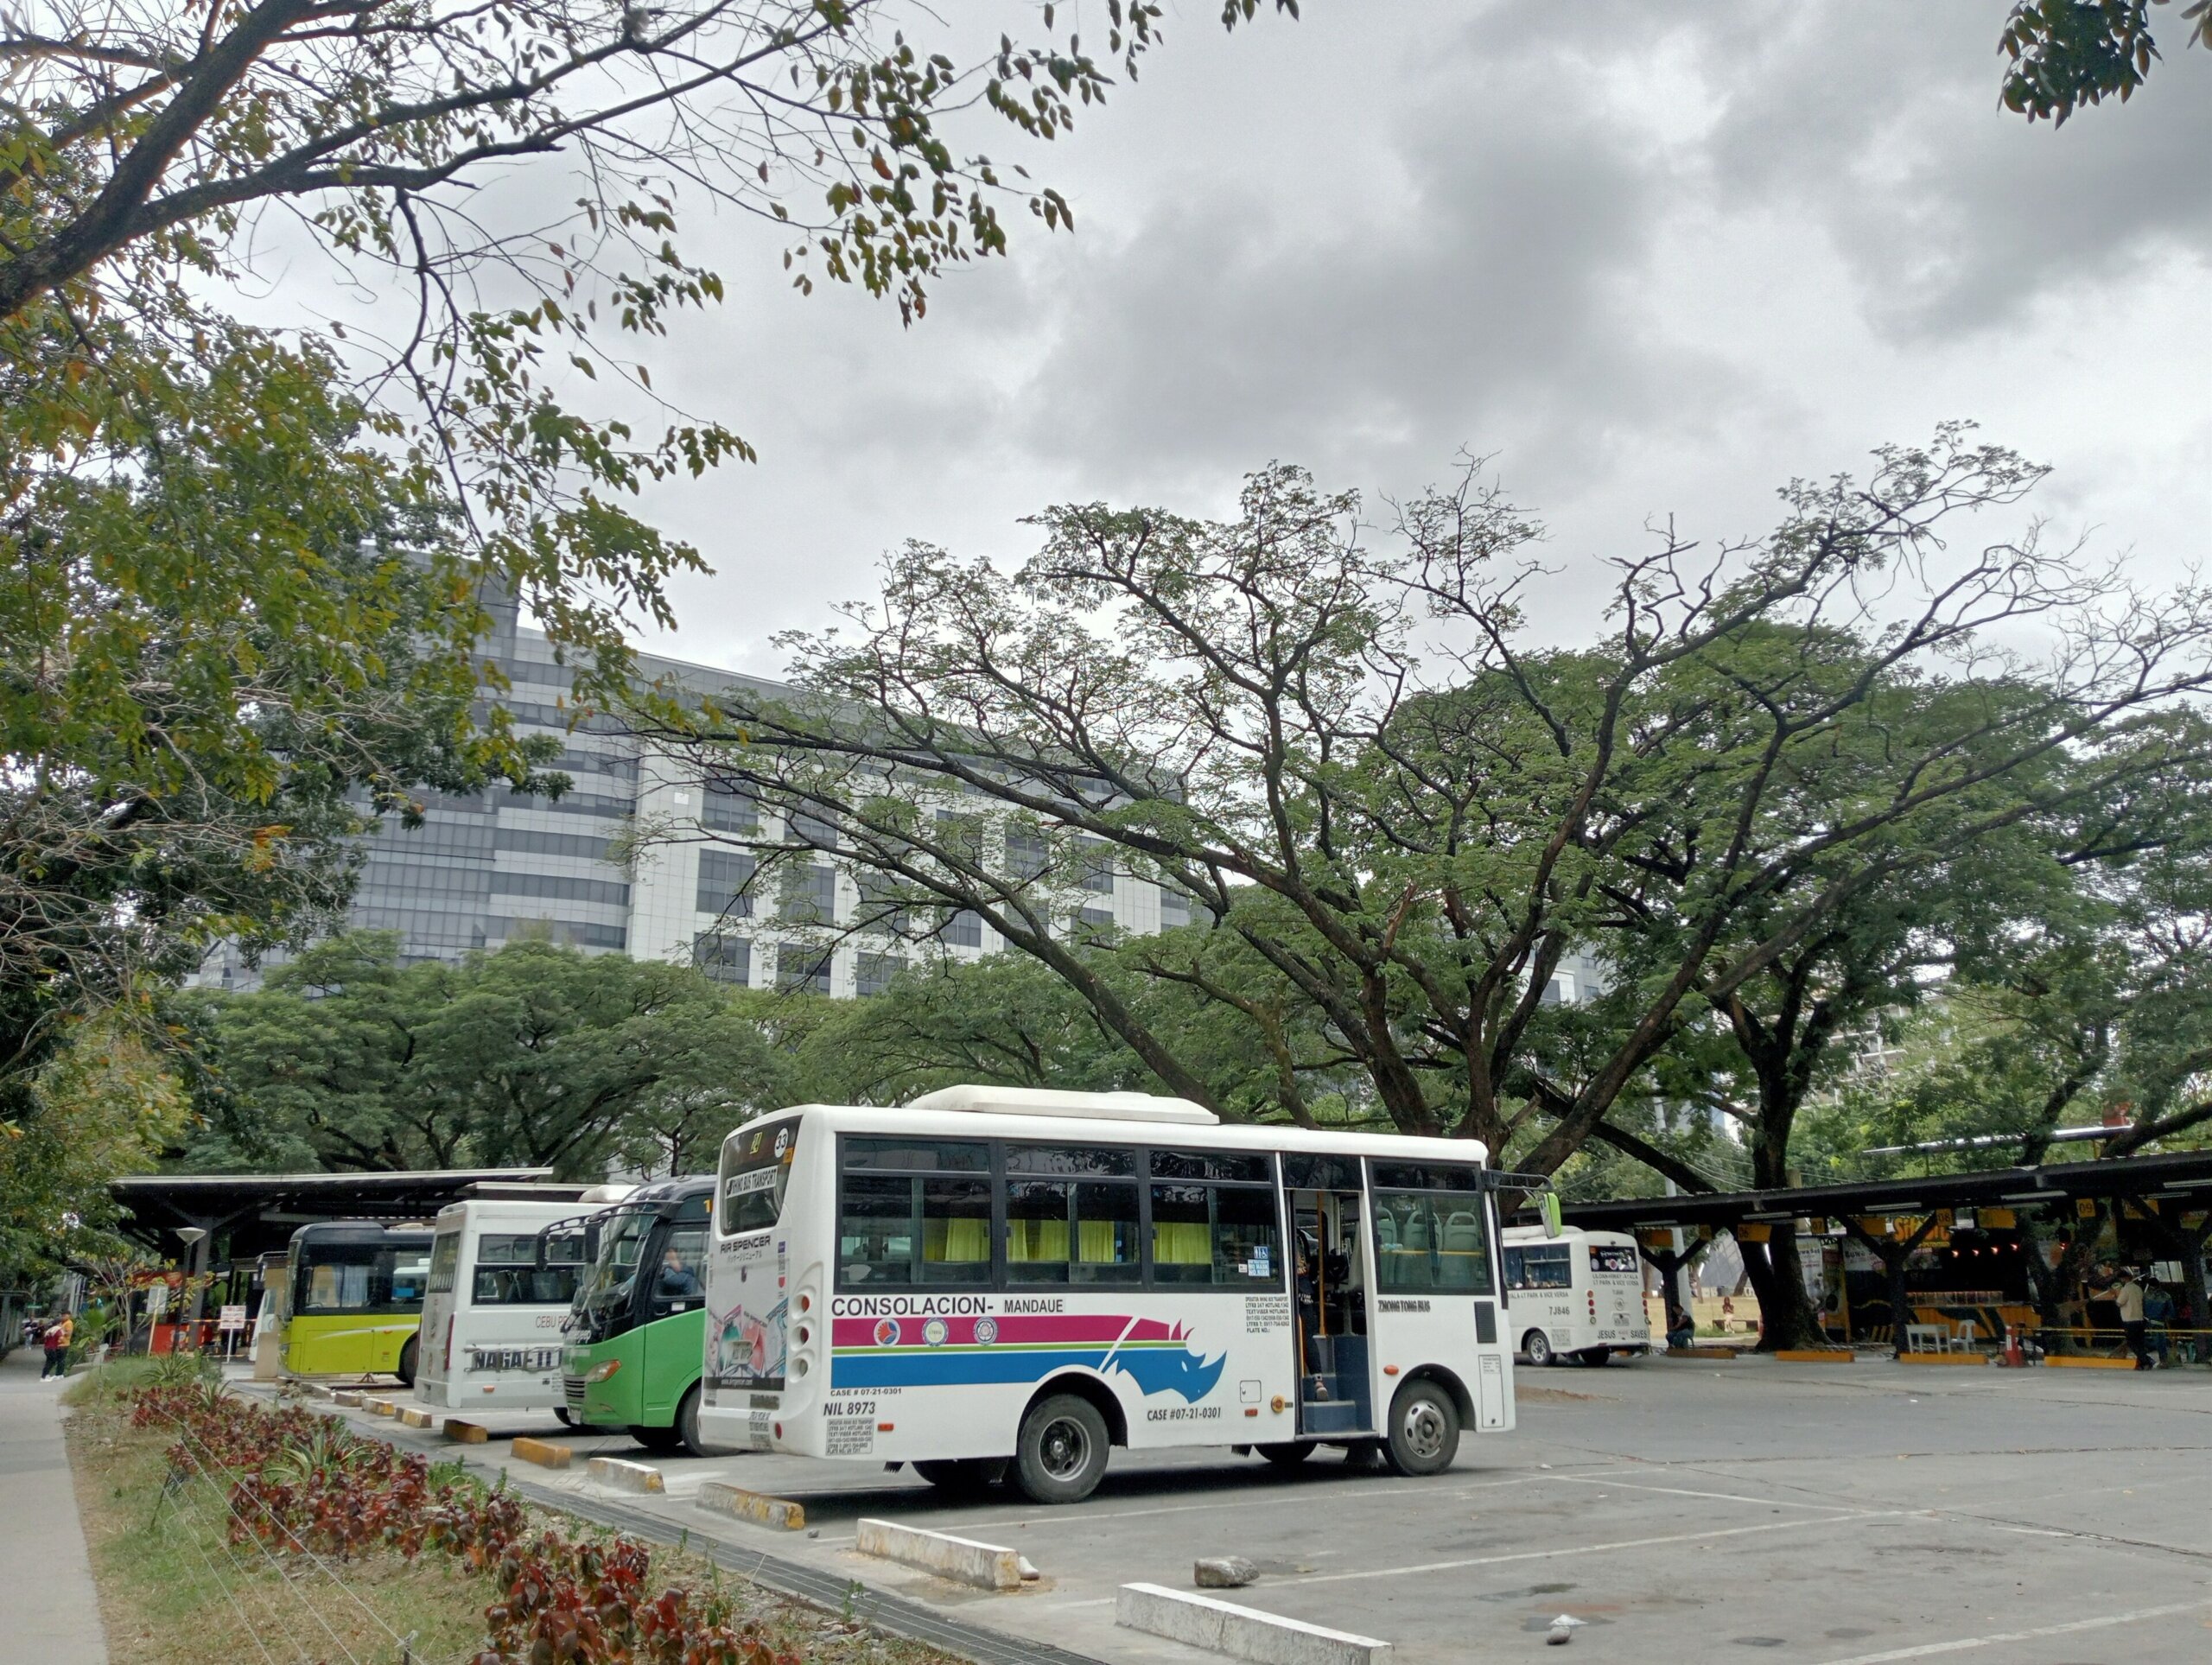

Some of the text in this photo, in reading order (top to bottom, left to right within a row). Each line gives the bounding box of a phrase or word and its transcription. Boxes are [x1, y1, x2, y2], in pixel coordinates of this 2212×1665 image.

[775, 1134, 787, 1150] 33
[2079, 1202, 2093, 1215] 09
[721, 1243, 732, 1255] AIR
[733, 1235, 771, 1253] SPENCER
[1004, 1299, 1064, 1313] MANDAUE
[1548, 1306, 1571, 1316] 7J846
[536, 1316, 556, 1328] CEBU
[1598, 1330, 1616, 1339] JESUS
[1630, 1329, 1648, 1339] SAVES
[823, 1401, 876, 1416] NIL 8973
[1147, 1407, 1221, 1421] CASE #07-21-0301
